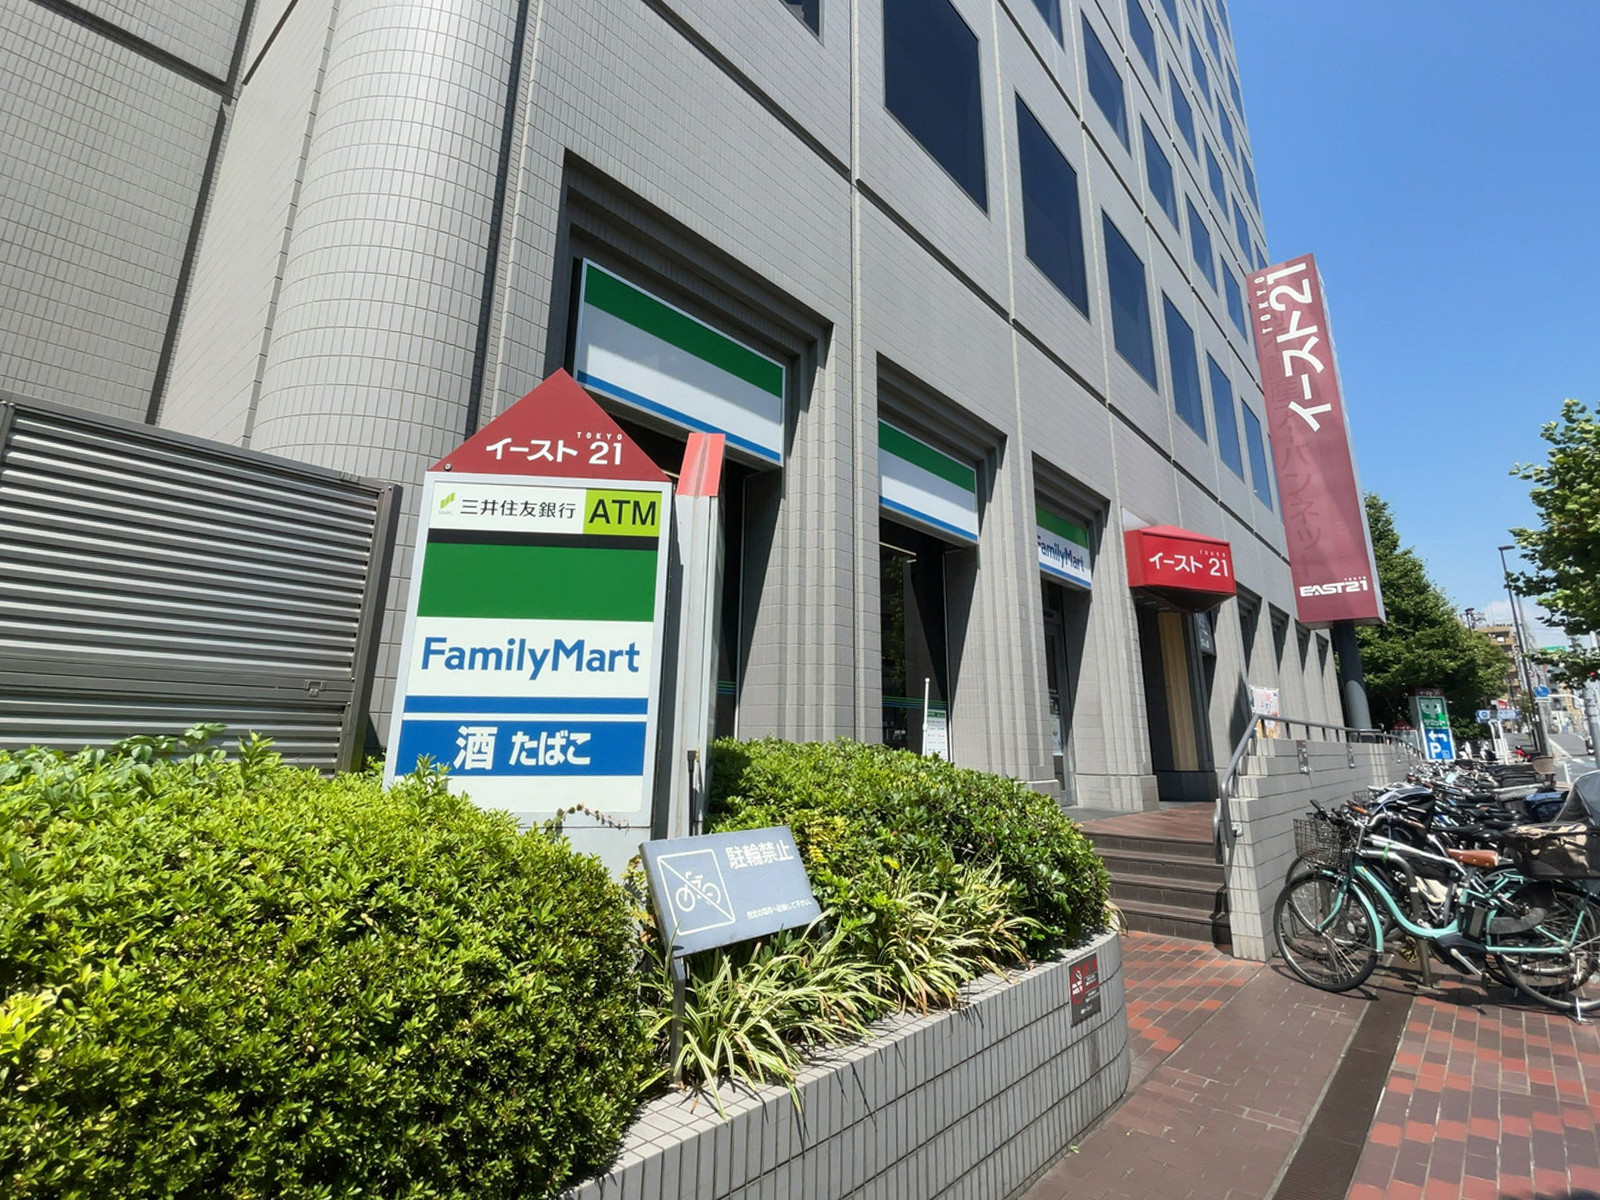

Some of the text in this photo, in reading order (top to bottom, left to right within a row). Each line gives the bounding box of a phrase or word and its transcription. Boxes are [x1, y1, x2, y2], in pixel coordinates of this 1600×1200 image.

[1253, 276, 1274, 334] TOKYO
[576, 431, 624, 441] TOKYO
[485, 437, 623, 465] イースト 21
[459, 498, 657, 526] 三井住友銀行 ATM
[1149, 552, 1204, 575] イースト
[1208, 557, 1229, 578] 21
[421, 636, 641, 681] FamilyMart
[453, 725, 592, 771] 酒 たばこ
[1429, 742, 1442, 758] P
[725, 839, 795, 870] 駐輪禁止
